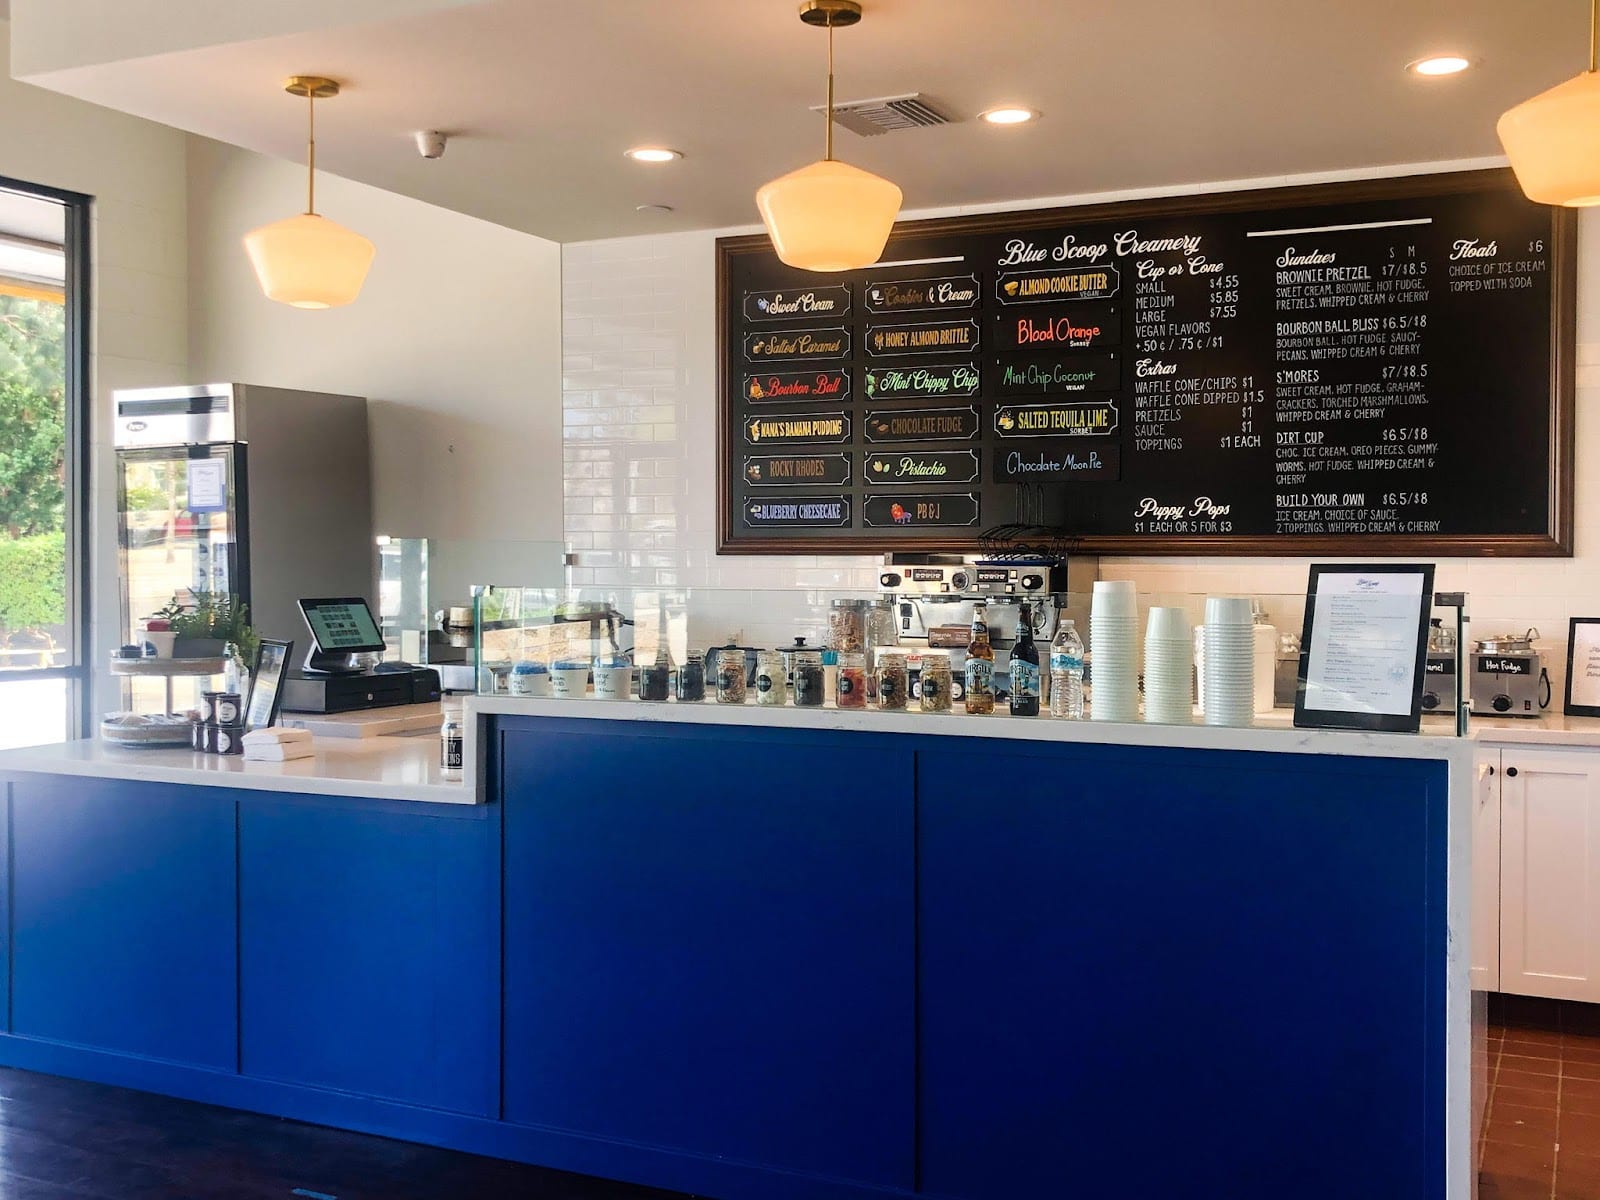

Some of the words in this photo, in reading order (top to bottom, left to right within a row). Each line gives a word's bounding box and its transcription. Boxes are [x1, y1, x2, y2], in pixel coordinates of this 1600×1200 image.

[998, 239, 1047, 266] Blue
[1052, 235, 1108, 263] Scoop
[1114, 230, 1202, 257] Creamery
[1276, 246, 1336, 268] Sundaes
[1389, 247, 1395, 259] S
[1408, 245, 1415, 257] M
[1449, 238, 1497, 260] Floats
[1528, 240, 1543, 253] $6
[1136, 259, 1166, 282] Cup
[1168, 264, 1184, 276] or
[1187, 255, 1224, 275] Cone
[1276, 268, 1323, 284] BROWNIE
[1326, 266, 1372, 281] PRETZEL
[1449, 264, 1482, 277] CHOICE
[1483, 263, 1496, 274] OF
[1497, 262, 1513, 274] ICE
[1515, 260, 1545, 272] CREAM
[1019, 278, 1050, 296] ALMOND
[1051, 275, 1079, 293] COOKIE
[1079, 273, 1107, 291] BUTTER
[1136, 281, 1166, 294] SMALL
[1210, 275, 1239, 289] $4.55
[1276, 286, 1302, 298] SWEET
[1376, 280, 1393, 292] HOT
[1450, 280, 1482, 292] TOPPED
[1483, 278, 1507, 290] WITH
[1509, 276, 1532, 289] SODA
[884, 286, 924, 306] Cookies
[926, 286, 935, 303] &
[937, 282, 974, 303] Cream
[1079, 290, 1100, 298] VEGAN
[1136, 295, 1175, 309] MEDIUM
[1210, 290, 1239, 303] $5.85
[1319, 295, 1356, 308] WHIPPED
[1358, 293, 1386, 305] CREAM
[1388, 292, 1395, 302] &
[1397, 290, 1430, 302] CHERRY
[770, 294, 802, 314] Sweet
[801, 293, 834, 312] Cream
[1136, 310, 1166, 323] LARGE
[1210, 305, 1237, 318] $7.55
[1018, 318, 1054, 344] Blood
[1056, 318, 1101, 342] Orange
[1136, 324, 1165, 338] VEGAN
[1169, 321, 1211, 336] FLAVORS
[1276, 321, 1322, 336] BOURBON
[1325, 319, 1351, 333] BALL
[1352, 318, 1380, 331] BLISS
[765, 336, 797, 354] Salted
[798, 335, 840, 353] Caramel
[885, 332, 909, 347] HONEY
[910, 330, 939, 346] ALMOND
[940, 328, 969, 344] BRITTLE
[1178, 337, 1194, 350] .75
[1276, 336, 1314, 348] BOURBON
[1341, 334, 1358, 345] HOT
[1359, 333, 1386, 344] FUDGE
[1311, 347, 1348, 359] WHIPPED
[1350, 346, 1377, 358] CREAM
[1389, 344, 1421, 356] CHERRY
[1136, 358, 1177, 378] Extras
[1276, 369, 1320, 384] S'MORES
[765, 377, 809, 396] Bourbon
[812, 374, 841, 394] Ball
[880, 371, 912, 391] Mint
[913, 369, 950, 393] Chippy
[952, 368, 979, 391] Chip
[1003, 365, 1026, 386] Mint
[1027, 364, 1052, 392] Chip
[1054, 364, 1096, 383] Coconut
[1135, 380, 1171, 393] WAFFLE
[1174, 377, 1237, 391] CONE/CHIPS
[1242, 376, 1253, 389] $1
[1135, 395, 1171, 408] WAFFLE
[1174, 393, 1200, 406] CONE
[1203, 391, 1240, 404] DIPPED
[1243, 390, 1265, 403] $1.5
[1276, 386, 1302, 397] SWEET
[1336, 384, 1353, 395] HOT
[1321, 397, 1359, 409] TORCHED
[1018, 411, 1048, 429] SALTED
[1050, 410, 1085, 428] TEQUILA
[1087, 409, 1108, 427] LIME
[1135, 409, 1182, 422] PRETZELS
[1242, 406, 1252, 418] $1
[1276, 410, 1313, 422] WHIPPED
[1314, 409, 1342, 420] CREAM
[1344, 409, 1351, 419] &
[1353, 408, 1386, 419] CHERRY
[761, 422, 785, 438] NANA'S
[785, 421, 812, 437] BANANA
[812, 420, 842, 436] PUDDING
[891, 417, 935, 435] CHOCOLATE
[938, 416, 963, 433] FUDGE
[1135, 424, 1165, 436] SAUCE
[1241, 421, 1252, 433] $1
[1135, 437, 1183, 450] TOPPINGS
[1220, 436, 1231, 448] $1
[1234, 435, 1261, 448] EACH
[1276, 431, 1300, 444] DIRT
[1304, 431, 1325, 444] CUP
[1302, 447, 1317, 458] ICE
[1351, 445, 1373, 456] OREO
[769, 460, 794, 477] ROCKY
[795, 459, 825, 476] RHODES
[895, 457, 947, 477] Pistachio
[1006, 451, 1060, 474] Chocolate
[1062, 454, 1088, 470] Moon
[1089, 451, 1102, 469] Pie
[1308, 461, 1325, 471] HOT
[1357, 459, 1396, 470] WHIPPED
[1396, 458, 1425, 469] CREAM
[1428, 458, 1435, 468] &
[1275, 473, 1307, 485] CHERRY
[1134, 497, 1185, 520] Puppy
[1189, 496, 1231, 519] Pops
[1276, 494, 1308, 507] BUILD
[1311, 493, 1338, 506] YOUR
[1342, 493, 1364, 506] OWN
[762, 504, 797, 520] BLUEBERRY
[799, 503, 841, 519] CHEESECAKE
[917, 503, 927, 520] PB
[928, 504, 935, 519] &
[935, 504, 940, 519] J
[1276, 510, 1290, 521] ICE
[1324, 509, 1355, 520] CHOICE
[1358, 509, 1368, 520] OF
[1135, 521, 1144, 532] $1
[1150, 521, 1173, 532] EACH
[1175, 521, 1188, 532] OR
[1191, 521, 1197, 532] 5
[1200, 521, 1217, 532] FOR
[1220, 521, 1232, 532] $3
[1276, 523, 1283, 533] 2
[1328, 522, 1367, 533] WHIPPED
[1368, 521, 1396, 532] CREAM
[1398, 522, 1405, 532] &
[1407, 520, 1441, 532] CHERRY
[1425, 663, 1444, 672] amel
[1485, 660, 1499, 670] Hot
[1501, 660, 1521, 673] Fudge
